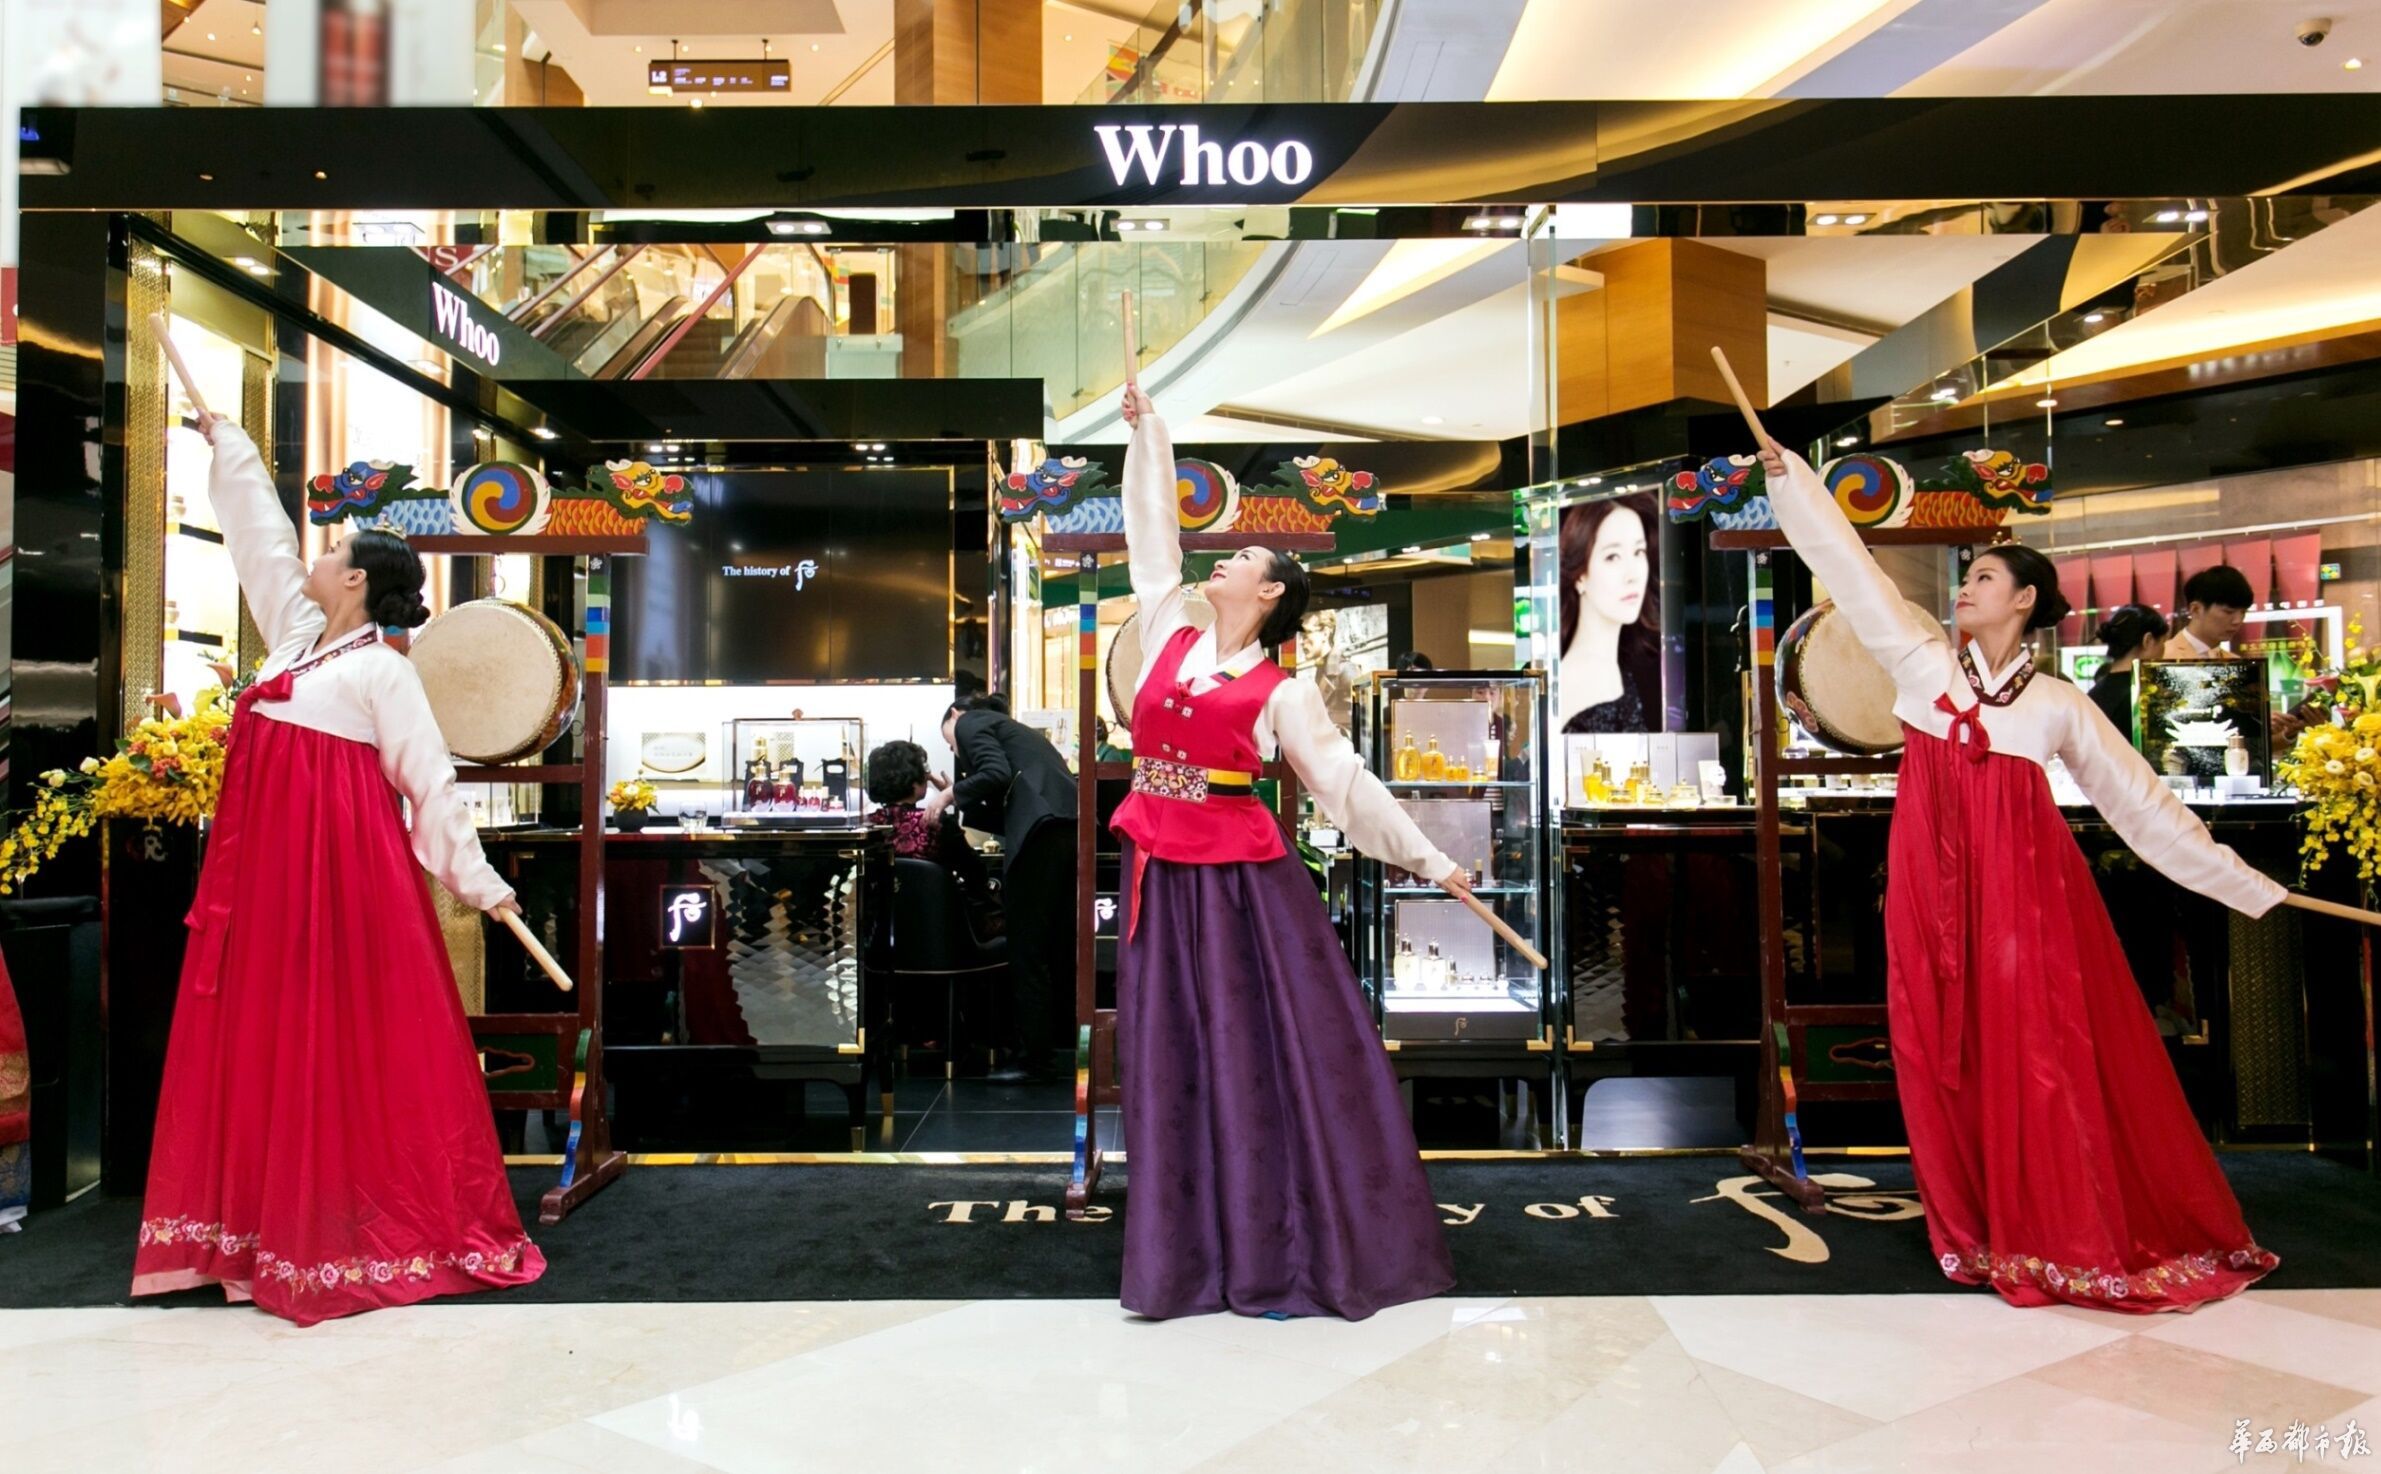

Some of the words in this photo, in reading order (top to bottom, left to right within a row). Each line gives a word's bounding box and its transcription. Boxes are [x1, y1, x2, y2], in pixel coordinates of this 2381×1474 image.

[1093, 124, 1313, 186] Whoo
[432, 281, 500, 366] Whoo
[722, 565, 742, 576] The
[743, 565, 778, 578] history
[780, 565, 791, 576] of
[928, 1200, 1113, 1223] The
[1524, 1195, 1621, 1220] of
